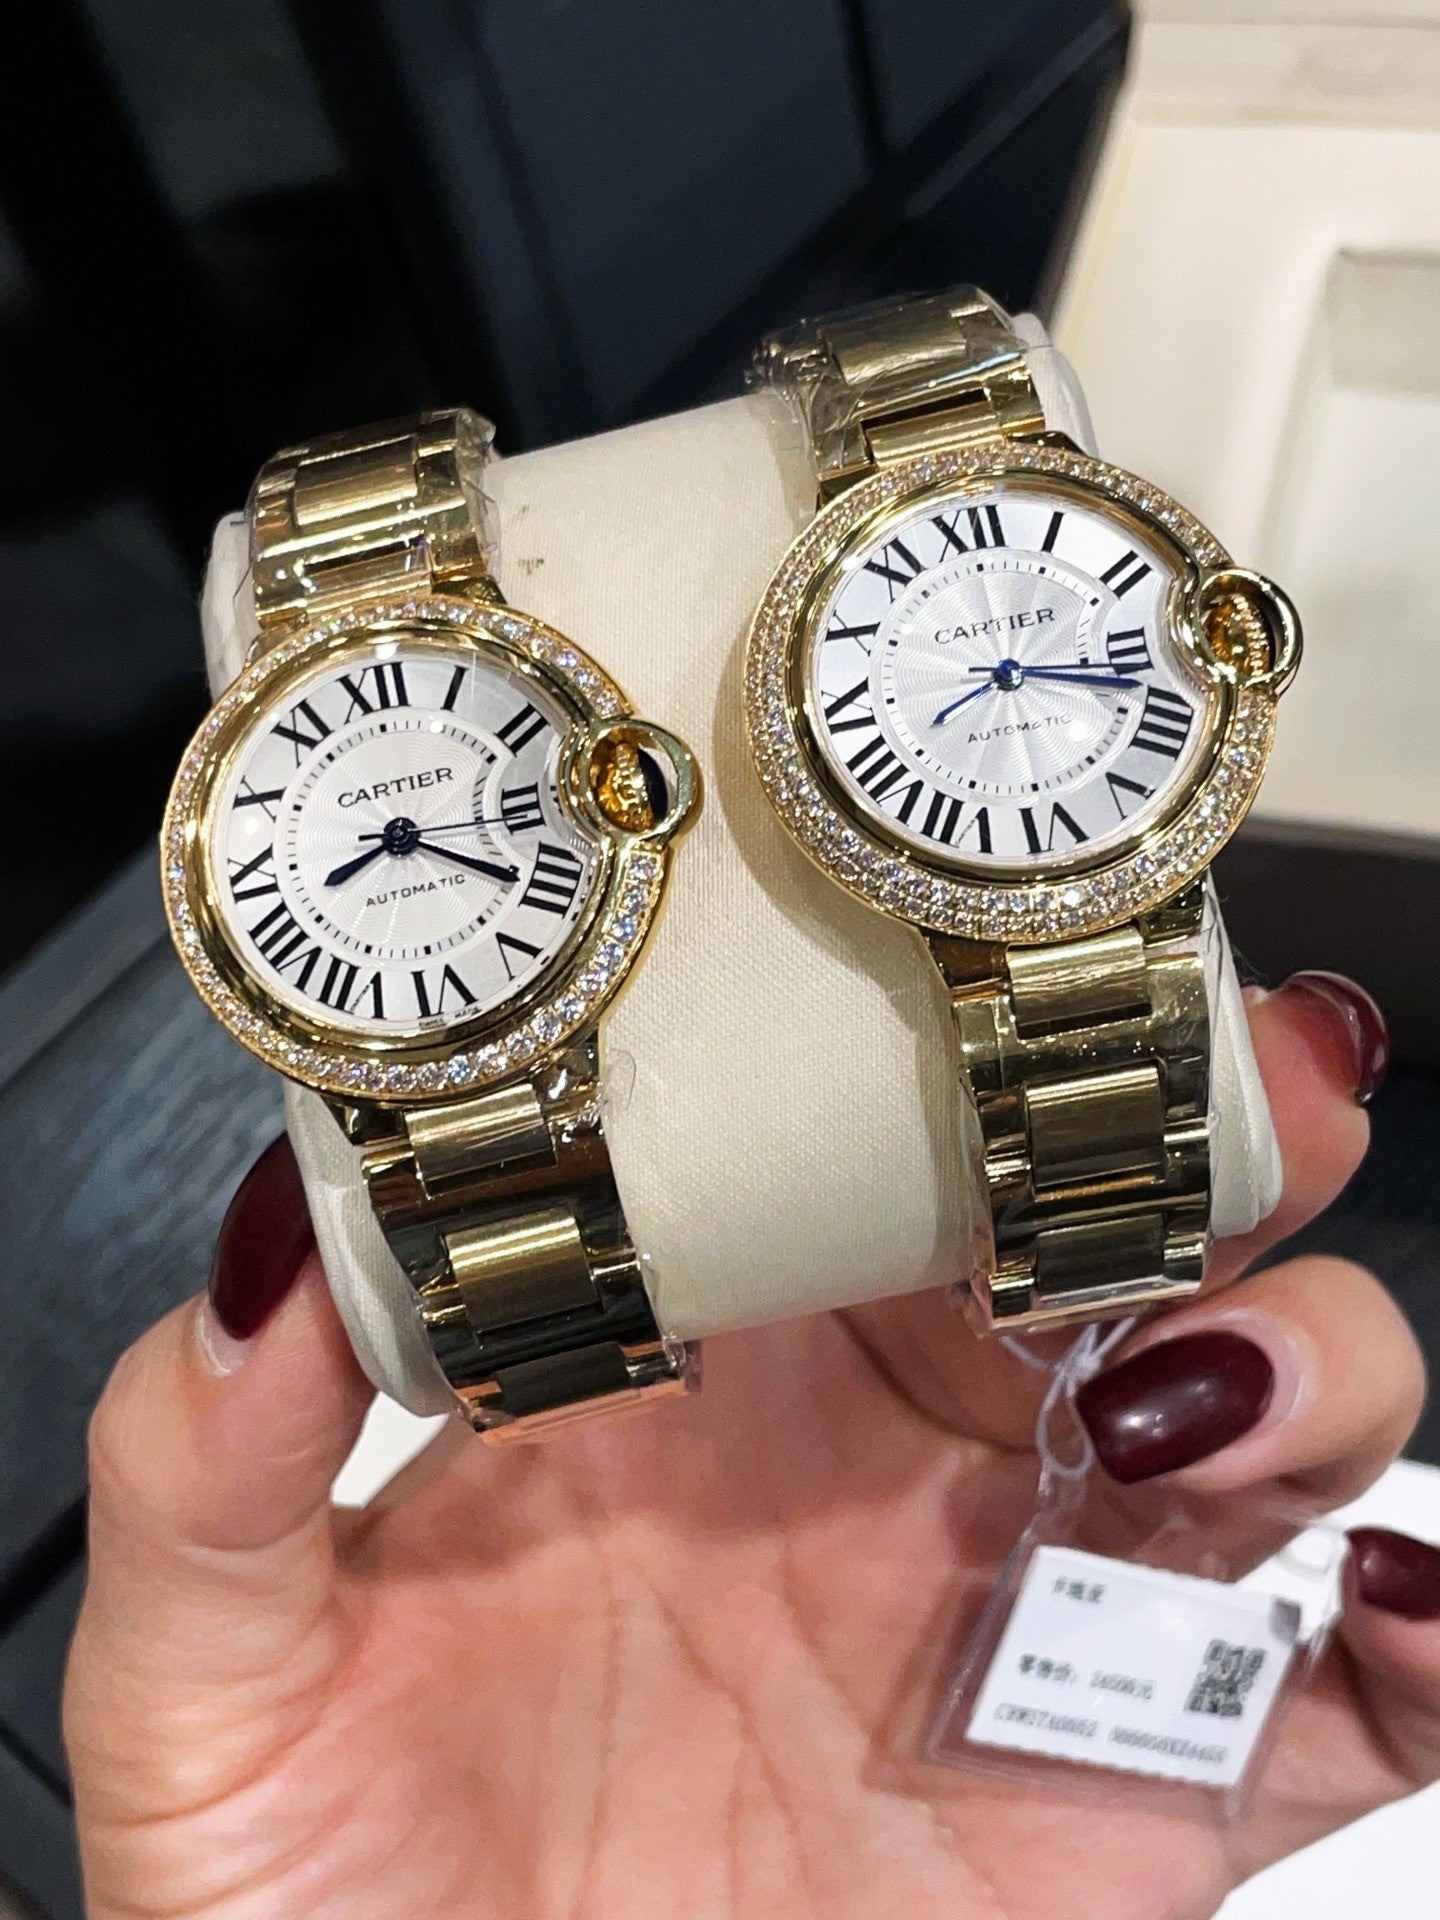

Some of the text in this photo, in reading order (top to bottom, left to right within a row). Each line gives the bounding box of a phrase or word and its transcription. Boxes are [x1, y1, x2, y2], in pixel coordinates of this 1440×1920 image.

[930, 504, 1008, 563] XII
[1040, 511, 1064, 554] I
[863, 537, 928, 604] XI
[1098, 550, 1153, 601] II
[825, 610, 881, 657] X
[934, 608, 1056, 645] CARTIER
[1106, 626, 1155, 676] III
[335, 661, 411, 725] XII
[440, 664, 470, 713] I
[270, 698, 335, 769] XI
[493, 702, 550, 757] II
[967, 713, 1073, 744] AUTOMATIC
[1127, 684, 1195, 762] IIII
[233, 775, 287, 823] X
[337, 767, 454, 808] CARTIER
[501, 782, 547, 835] III
[1105, 771, 1157, 821] V
[1018, 801, 1090, 855] VI
[366, 873, 466, 907] AUTOMATIC
[518, 841, 583, 919] IIII
[495, 932, 544, 981] V
[410, 964, 479, 1019] VI
